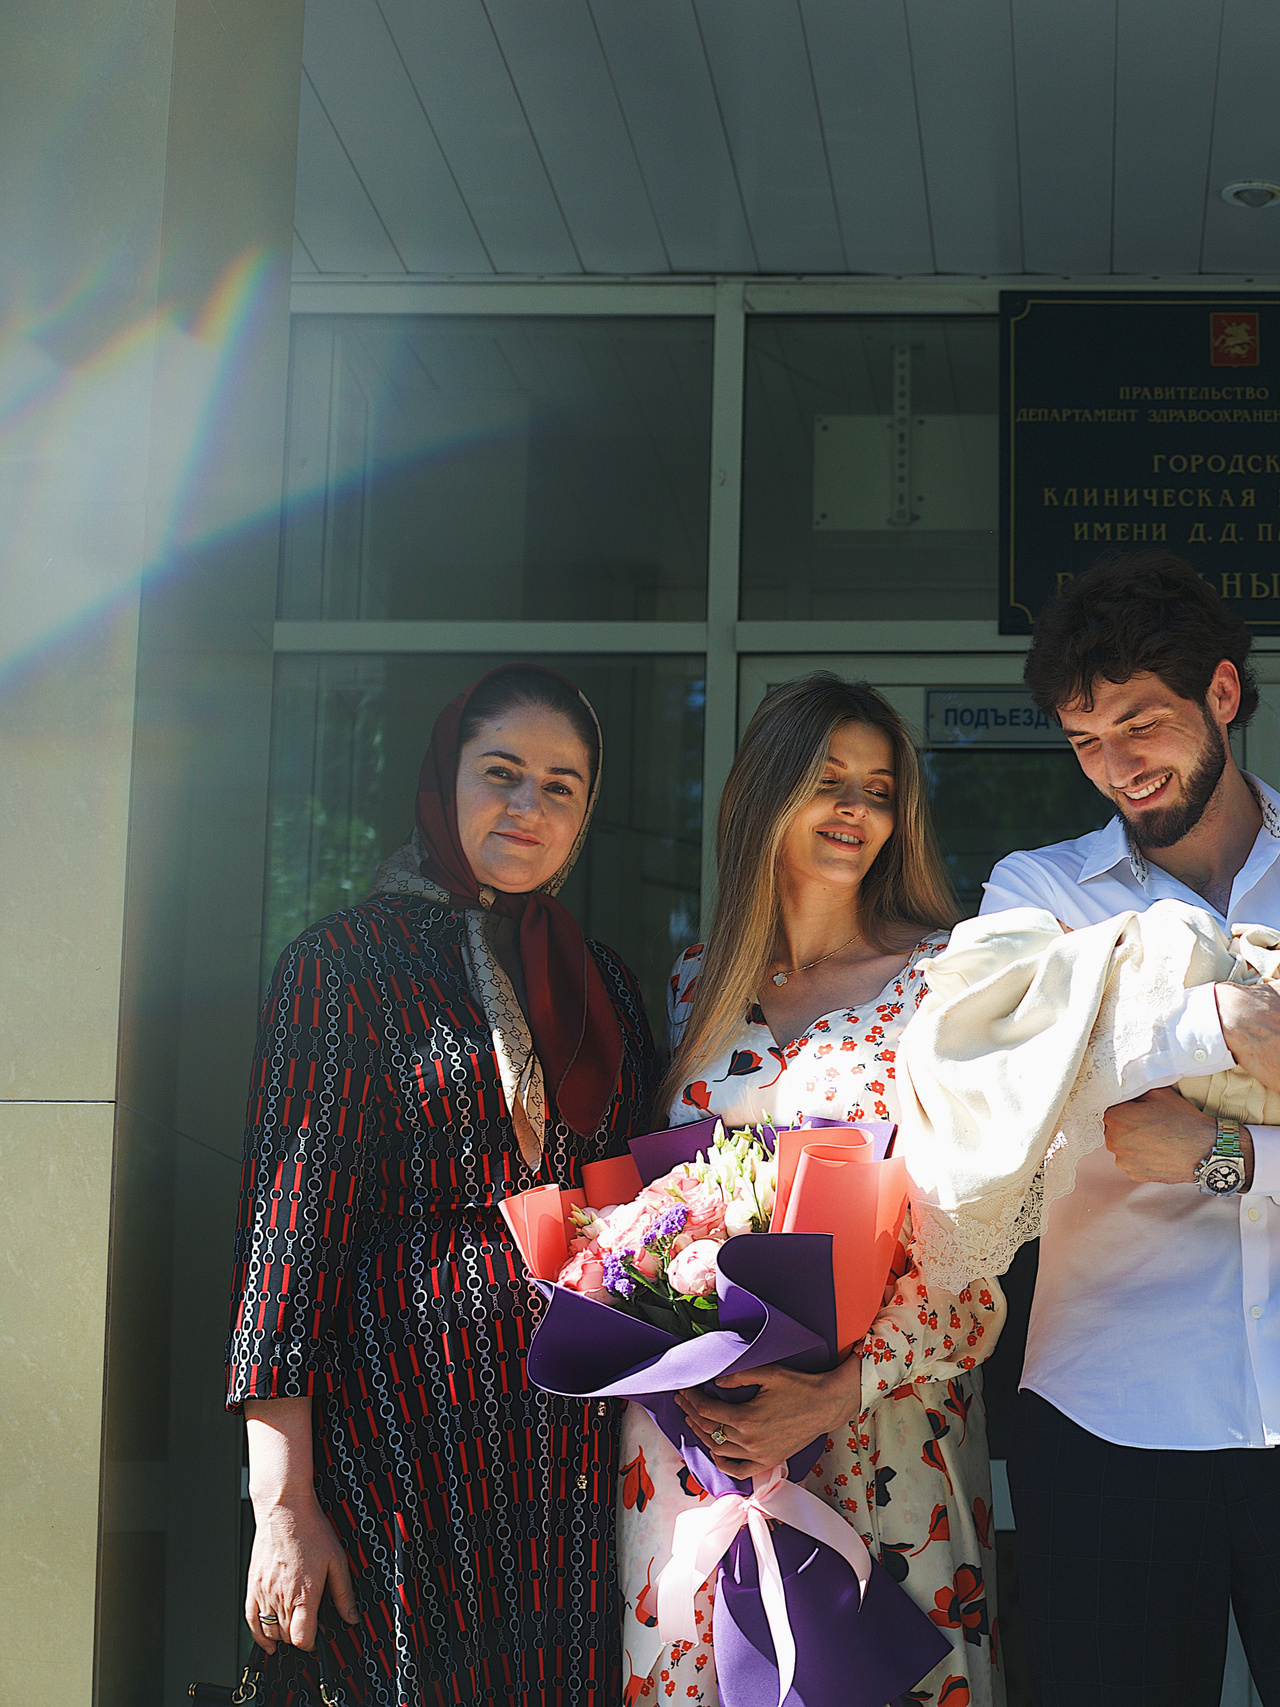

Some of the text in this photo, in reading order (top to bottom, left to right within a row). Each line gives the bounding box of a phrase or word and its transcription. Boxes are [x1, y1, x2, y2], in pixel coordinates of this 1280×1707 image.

[1119, 386, 1269, 400] ПРАВИТЕЛЬСТВО
[1015, 408, 1138, 423] ДЕПАРТАМЕНТ
[1043, 487, 1256, 507] КЛИНИЧЕСКАЯ
[1073, 522, 1167, 541] ИМЕНИ
[944, 707, 1049, 730] ПОДЪЕЗД
